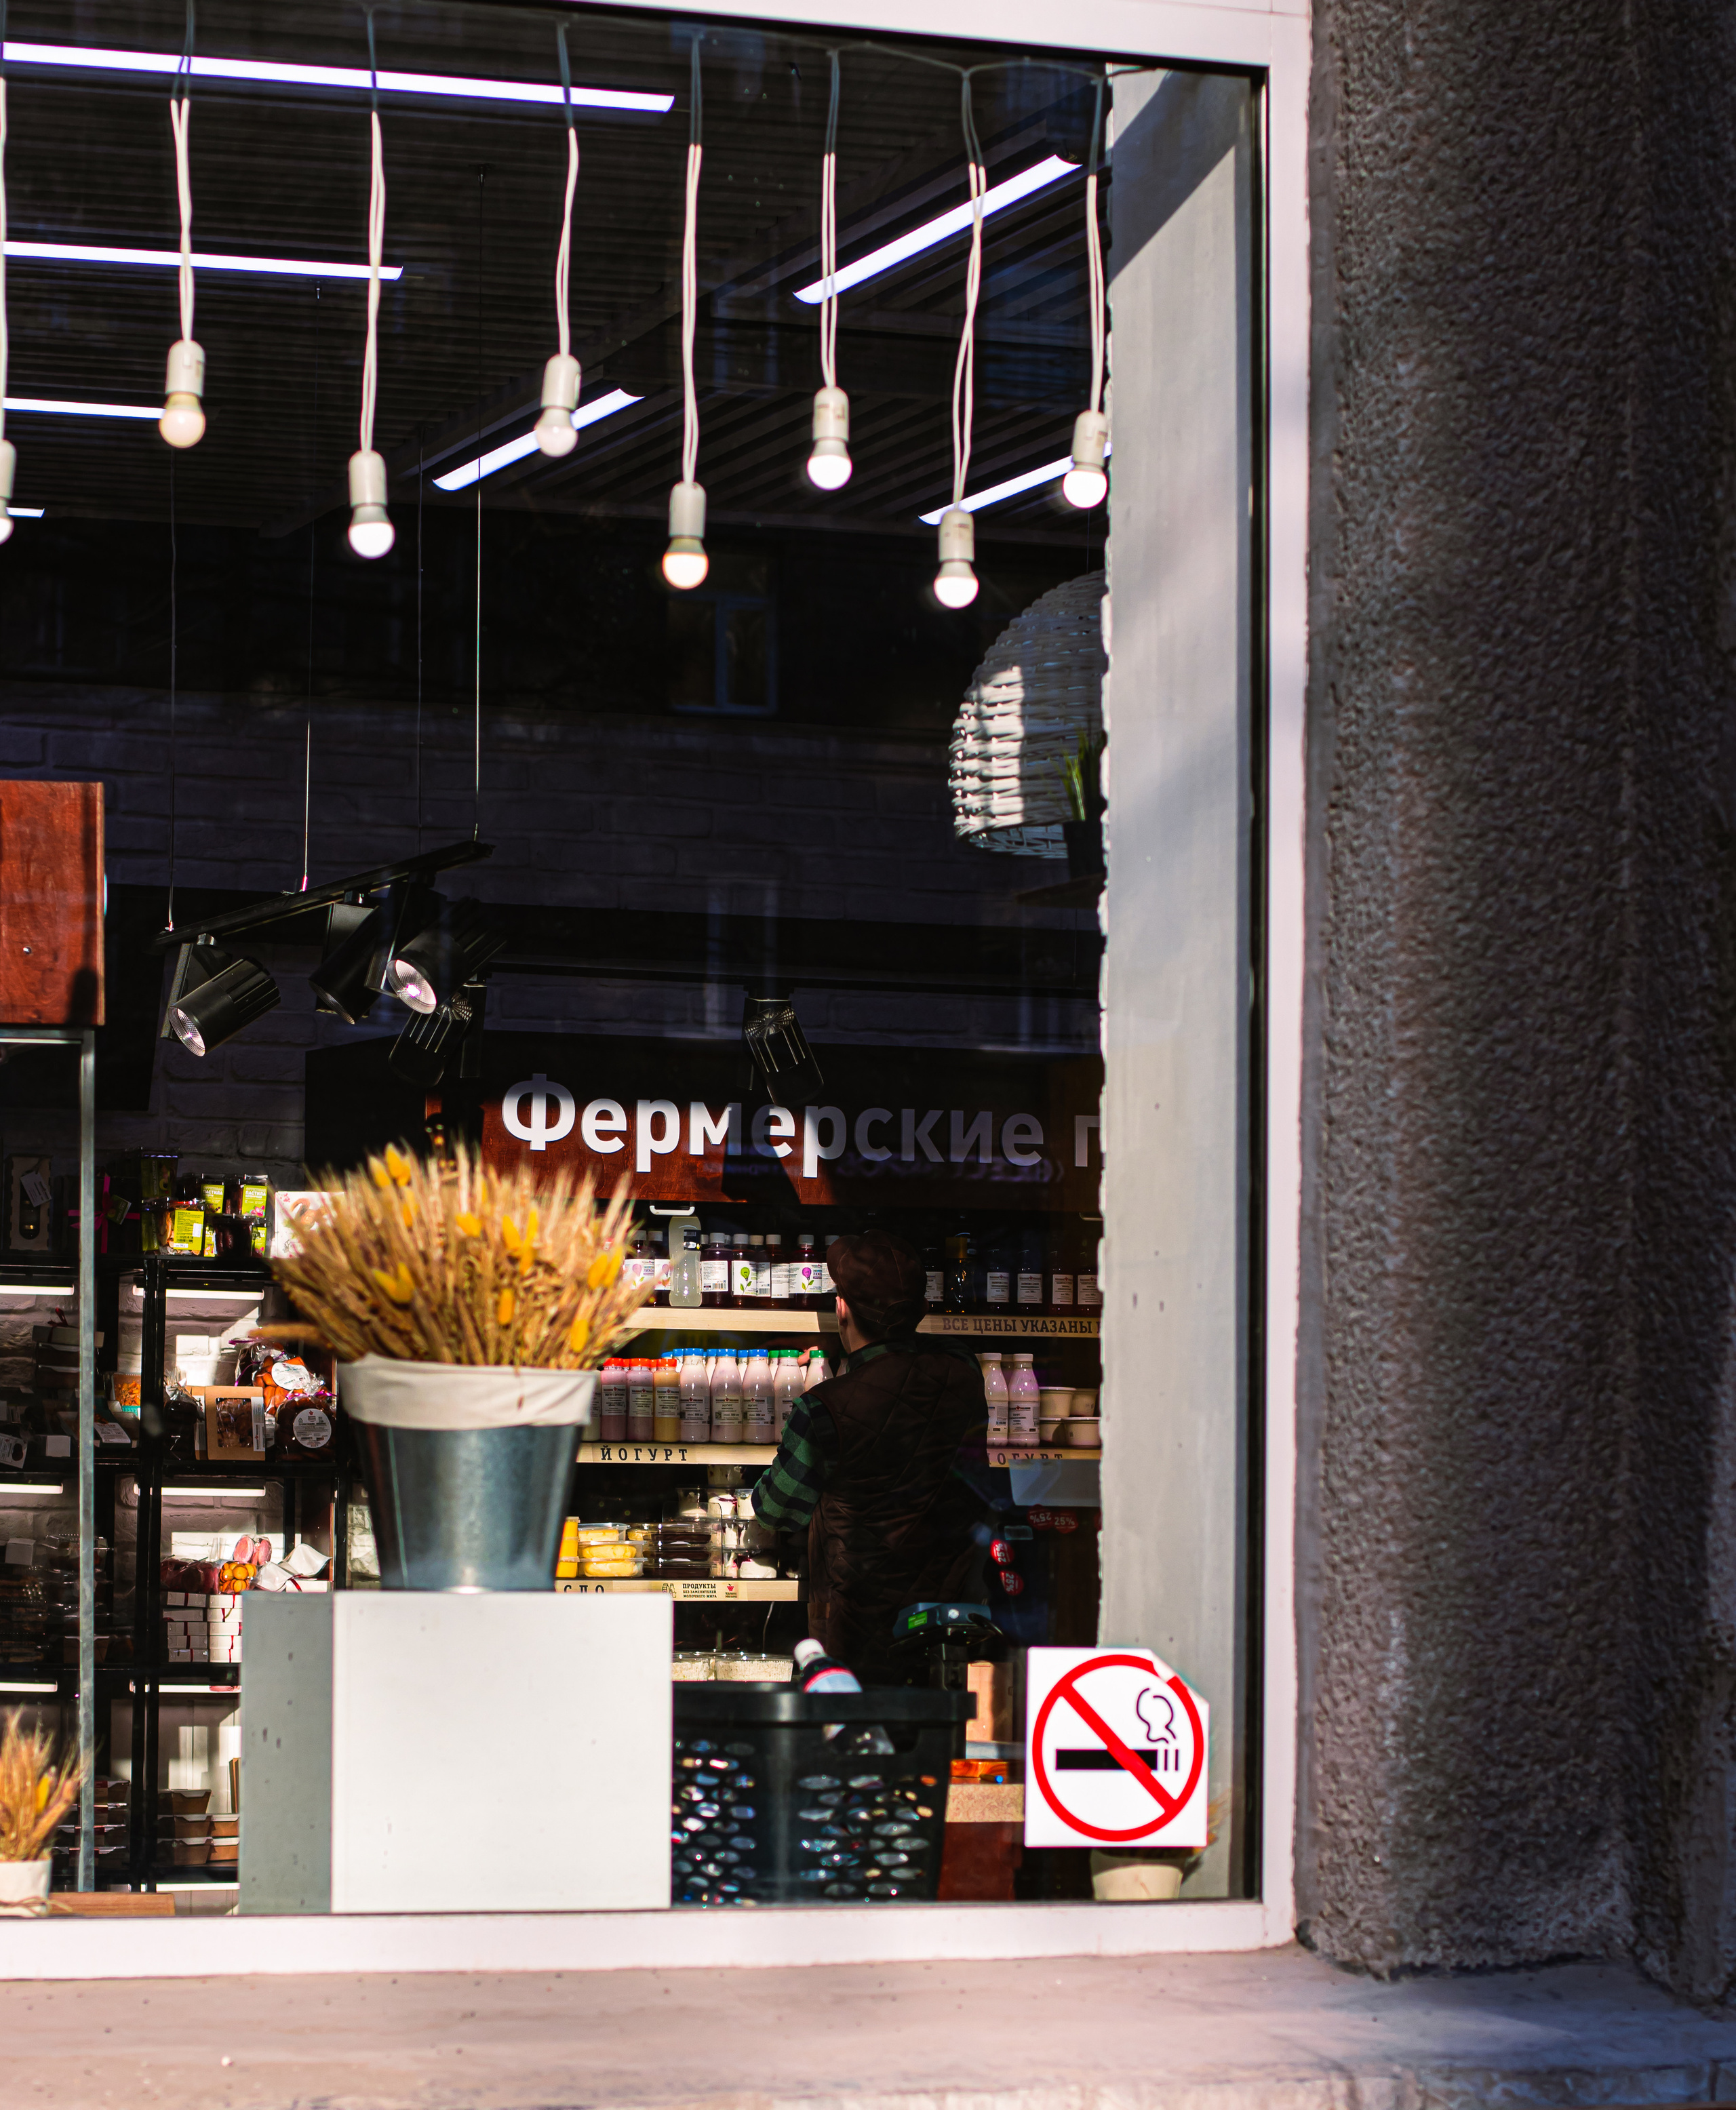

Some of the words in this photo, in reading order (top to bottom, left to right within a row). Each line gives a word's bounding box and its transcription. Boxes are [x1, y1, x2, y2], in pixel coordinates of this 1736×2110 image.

[502, 1073, 1044, 1178] Фермерские
[943, 1317, 968, 1331] ВСЕ
[973, 1319, 1017, 1334] ЦЕНЫ
[1020, 1319, 1092, 1334] УКАЗАНЫ
[600, 1445, 688, 1462] ЙОГУРТ
[1029, 1512, 1052, 1524] 25%
[1054, 1517, 1075, 1526] 25%
[1006, 1572, 1014, 1592] 25%
